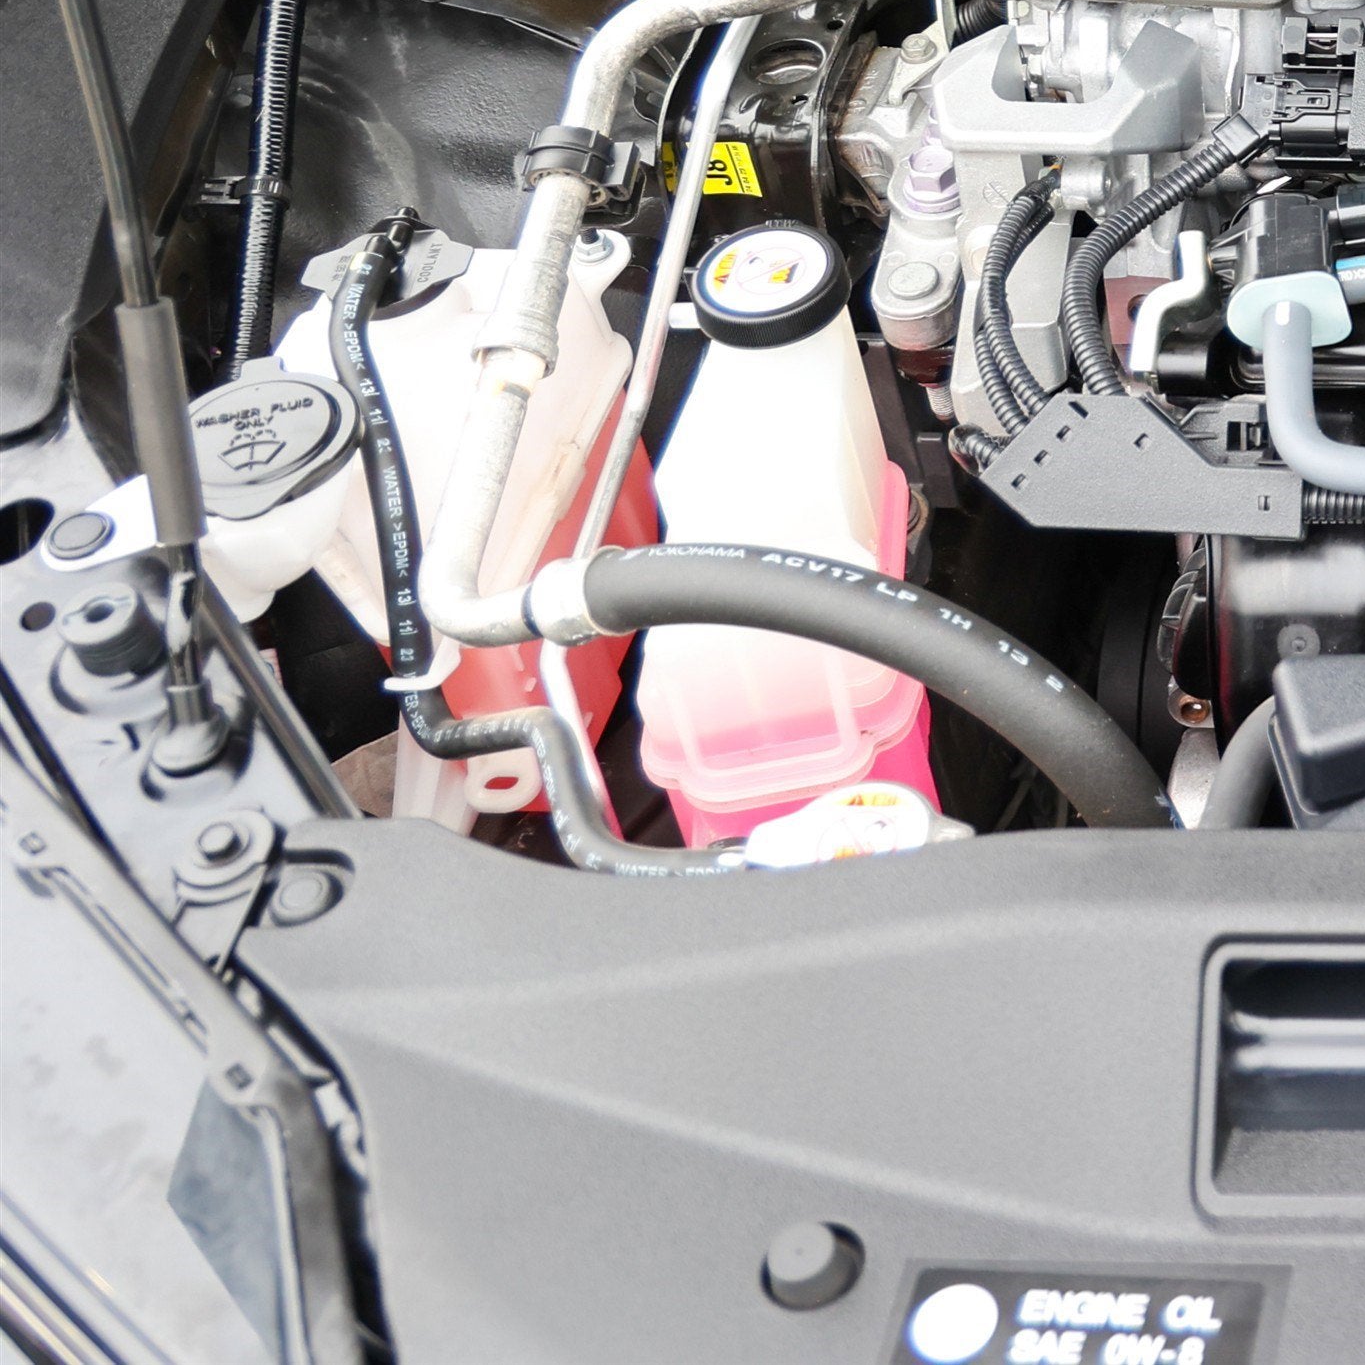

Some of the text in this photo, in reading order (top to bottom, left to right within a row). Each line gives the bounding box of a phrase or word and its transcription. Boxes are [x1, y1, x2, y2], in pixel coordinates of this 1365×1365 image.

[417, 242, 443, 283] COOLANT
[195, 397, 314, 428] WASHER FLUID
[342, 283, 365, 320] WATER
[381, 464, 404, 519] WATER
[234, 415, 275, 431] ONLY
[647, 545, 747, 559] YOKOHAMA
[876, 581, 918, 603] LP
[998, 640, 1030, 666] 13
[1016, 1288, 1223, 1333] ENGINE OIL
[1007, 1328, 1087, 1365] SAE
